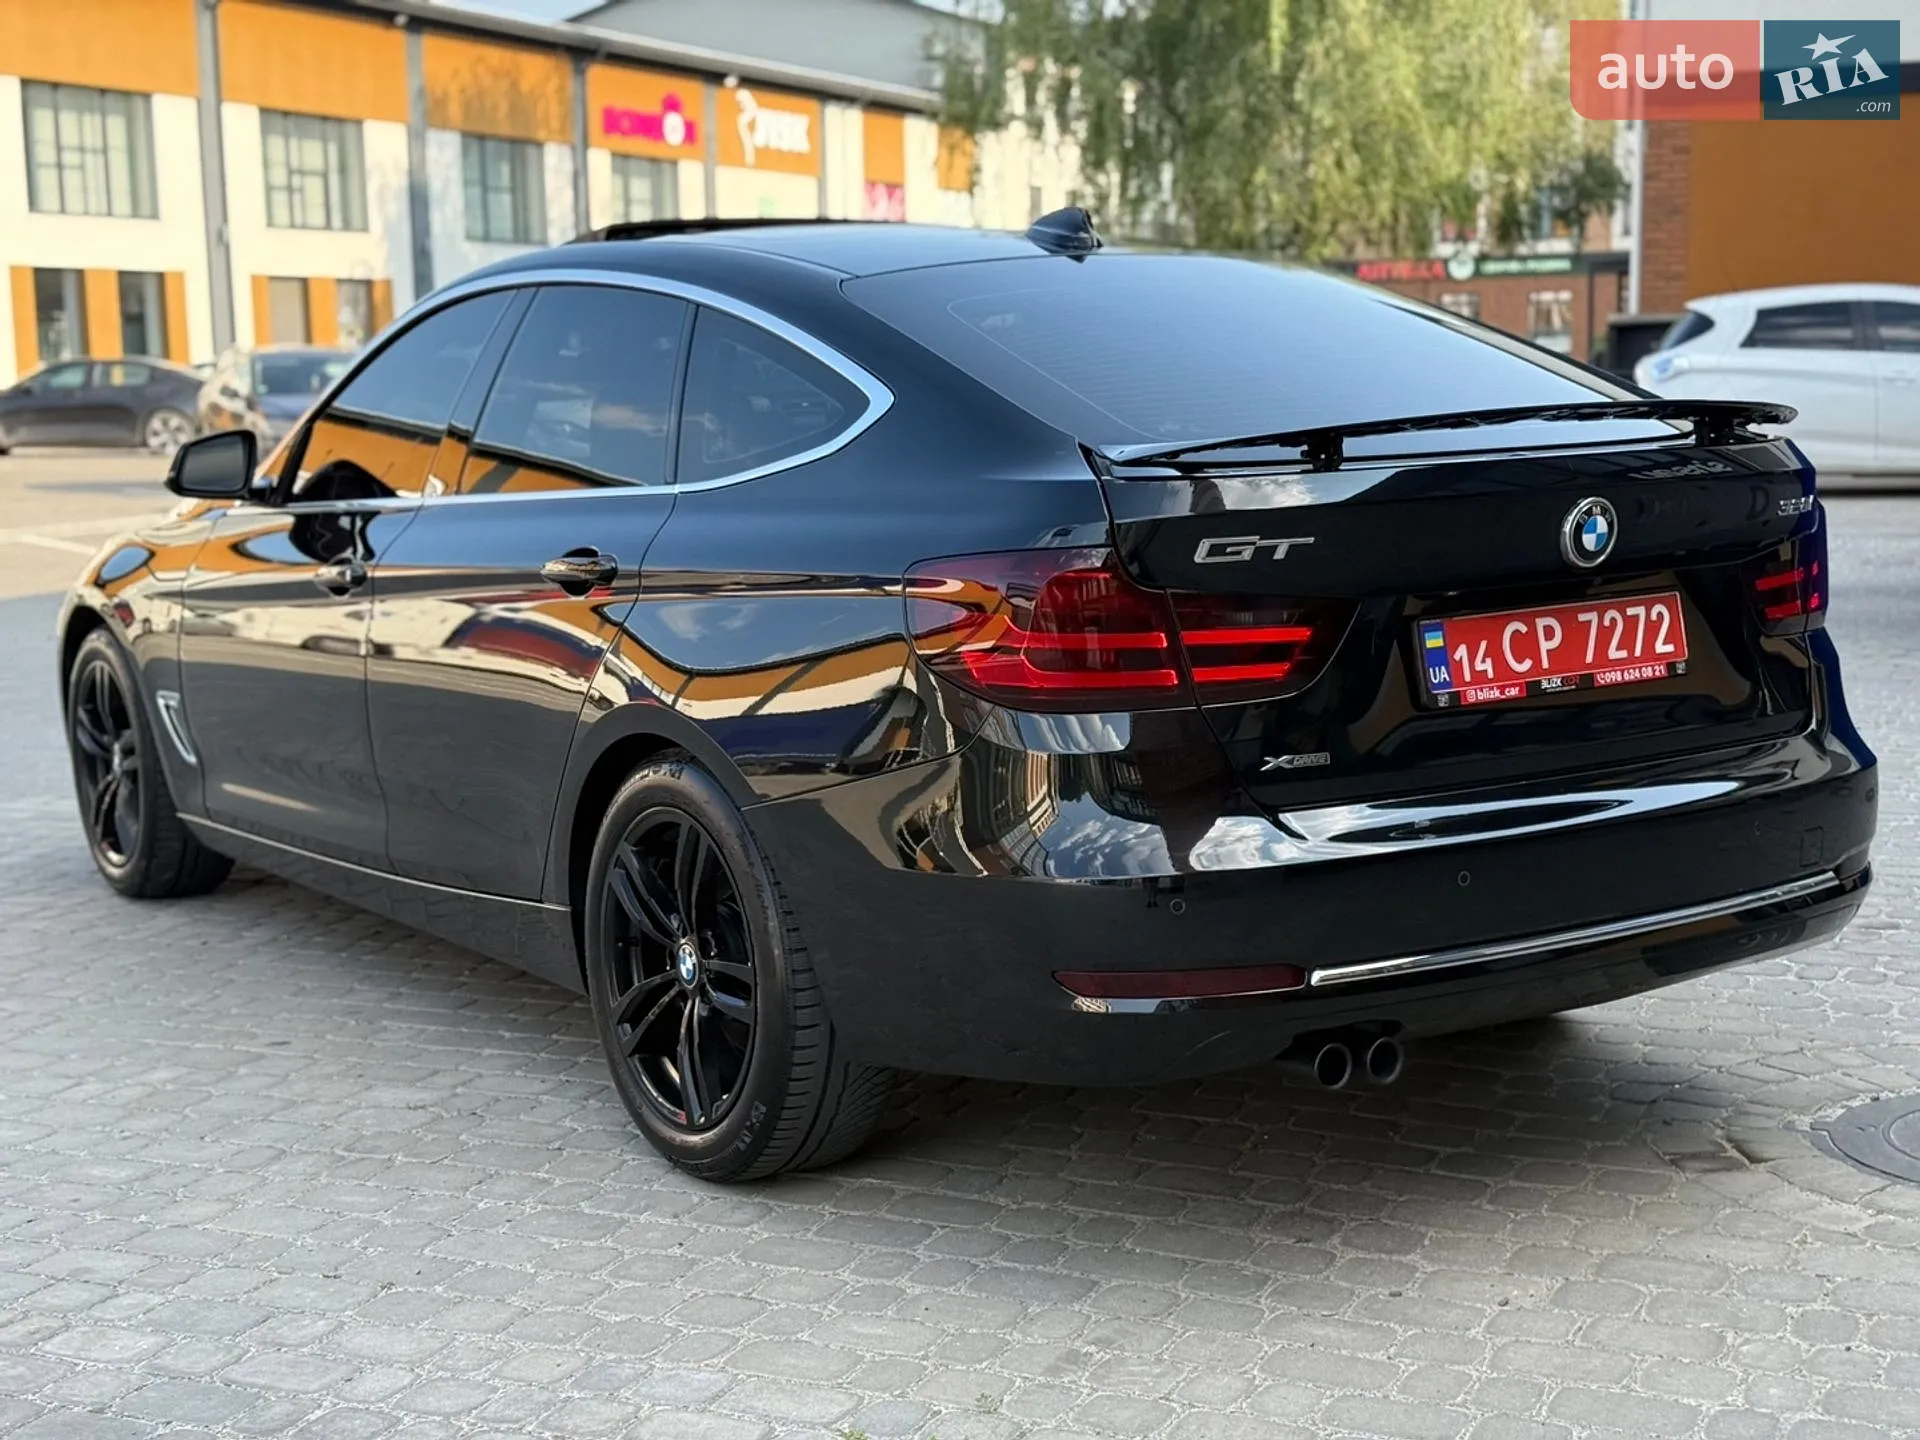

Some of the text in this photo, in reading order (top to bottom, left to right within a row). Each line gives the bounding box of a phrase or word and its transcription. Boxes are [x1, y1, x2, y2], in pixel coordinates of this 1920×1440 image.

[1194, 536, 1315, 563] GT
[1453, 603, 1675, 682] 14 CP 7272
[1429, 666, 1450, 684] UA
